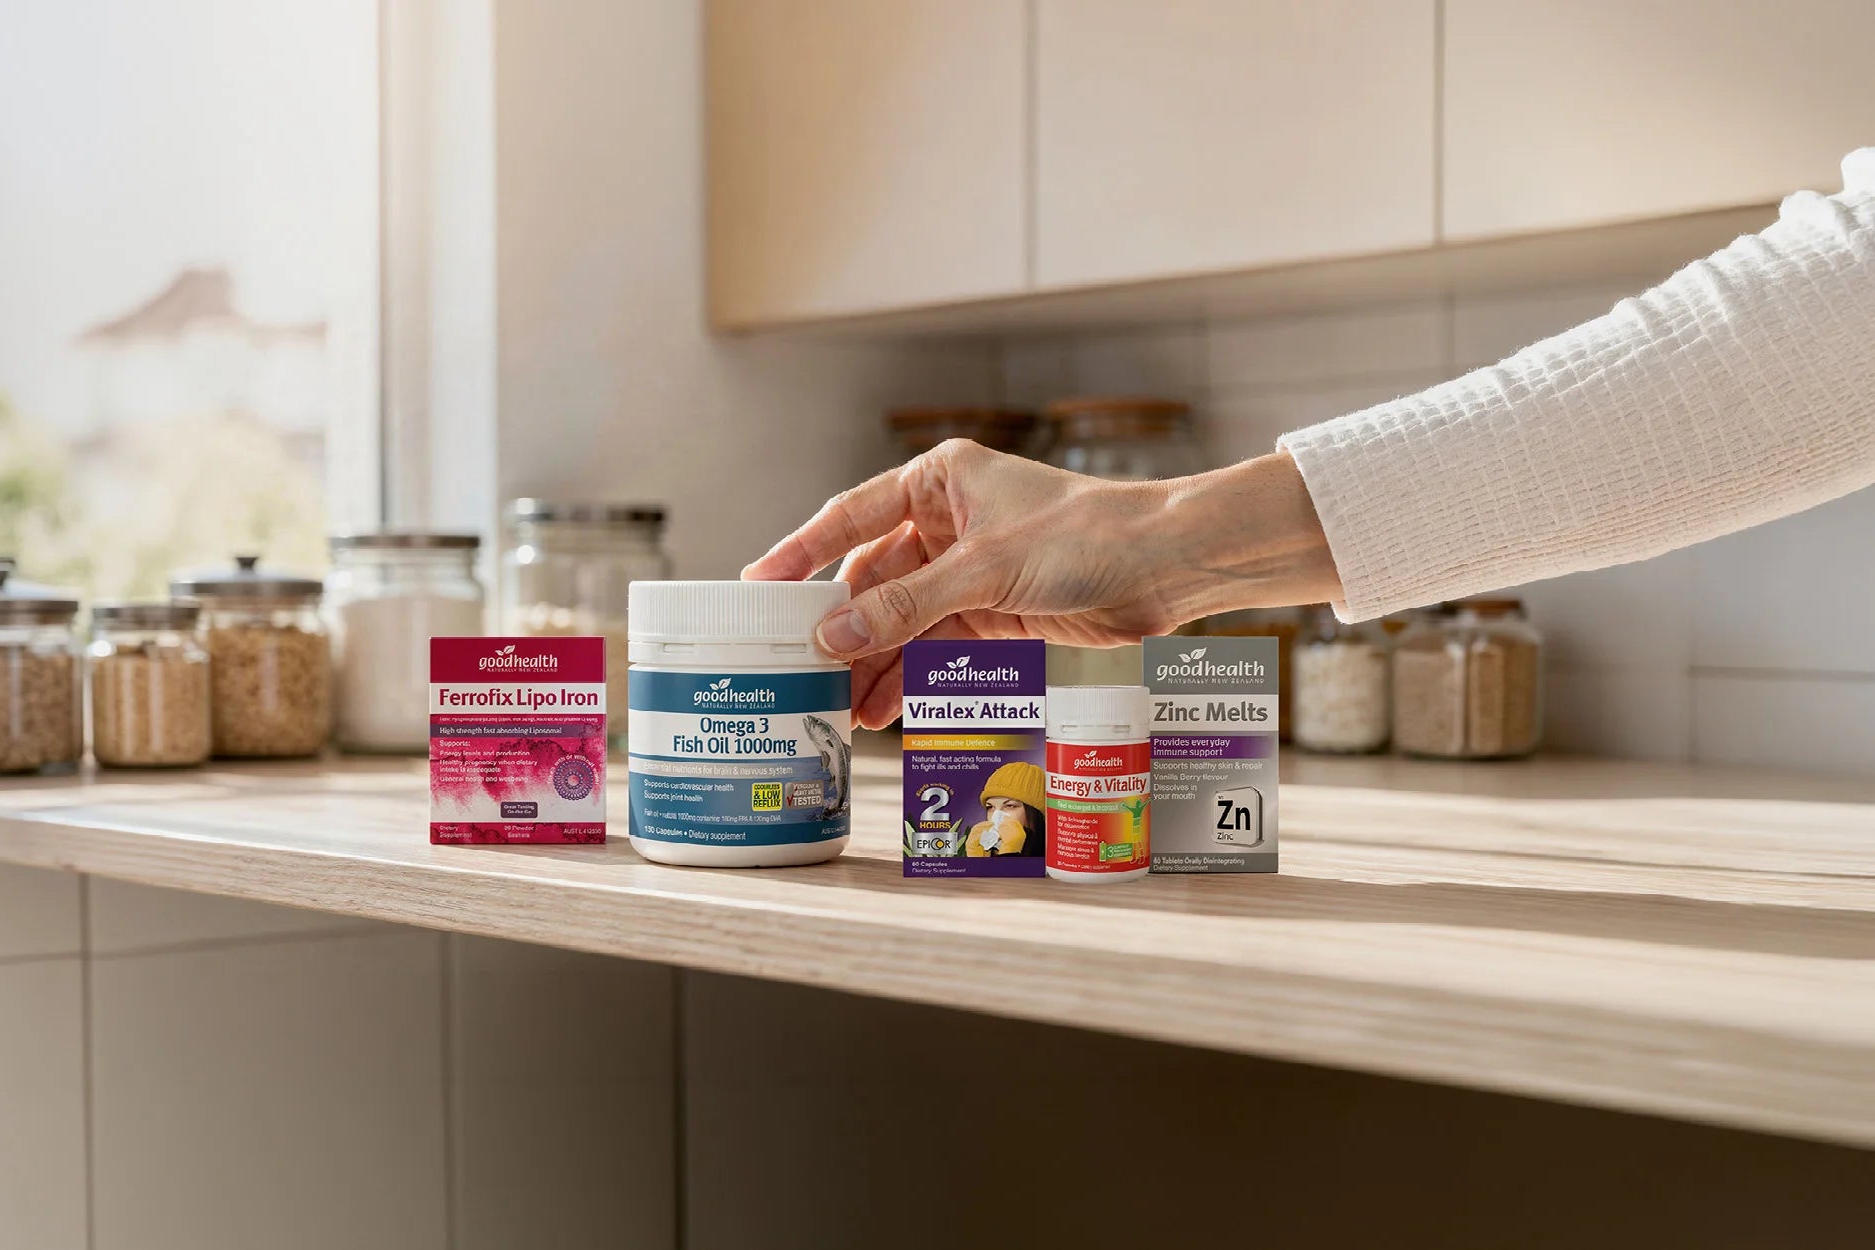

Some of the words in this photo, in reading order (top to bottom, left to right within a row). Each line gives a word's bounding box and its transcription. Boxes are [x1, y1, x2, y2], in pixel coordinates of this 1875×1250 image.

[479, 654, 558, 670] goodhealth
[928, 667, 1019, 685] goodhealth
[1157, 661, 1264, 680] goodhealth
[439, 688, 514, 706] Ferrofix
[516, 688, 557, 711] Lipo
[561, 688, 598, 706] Iron
[694, 688, 775, 705] goodhealth
[980, 702, 1040, 719] Attack
[1154, 701, 1200, 721] Zinc
[1206, 701, 1268, 721] Melts
[530, 727, 562, 735] Liposomal
[700, 718, 756, 736] Omega
[759, 718, 769, 734] 3
[674, 735, 703, 753] Fish
[708, 737, 730, 754] Oil
[734, 738, 797, 756] 1000mg
[912, 740, 932, 748] Rapid
[1191, 738, 1230, 747] everyday
[1154, 747, 1188, 756] immune
[1190, 748, 1222, 757] support
[954, 756, 974, 764] acting
[1074, 757, 1123, 769] goodhealth
[703, 766, 712, 774] for
[714, 766, 732, 775] brain
[768, 766, 793, 776] system
[1154, 762, 1188, 770] Supports
[1190, 762, 1216, 771] healthy
[1242, 762, 1263, 770] repair
[644, 778, 669, 789] Supports
[670, 782, 713, 791] cardiovascular
[1050, 776, 1092, 797] Energy
[1094, 780, 1102, 792] &
[1104, 777, 1146, 793] Vitality
[644, 790, 670, 800] Supports
[670, 792, 683, 801] joint
[754, 791, 761, 799] &
[762, 790, 780, 799] LOW
[793, 796, 821, 806] TESTED
[920, 787, 950, 821] 2
[1217, 800, 1251, 830] Zn
[689, 830, 710, 840] Dietary
[710, 832, 746, 841] supplement
[1217, 832, 1234, 840] Zinc
[1107, 846, 1114, 857] 3
[1184, 857, 1202, 865] Orally
